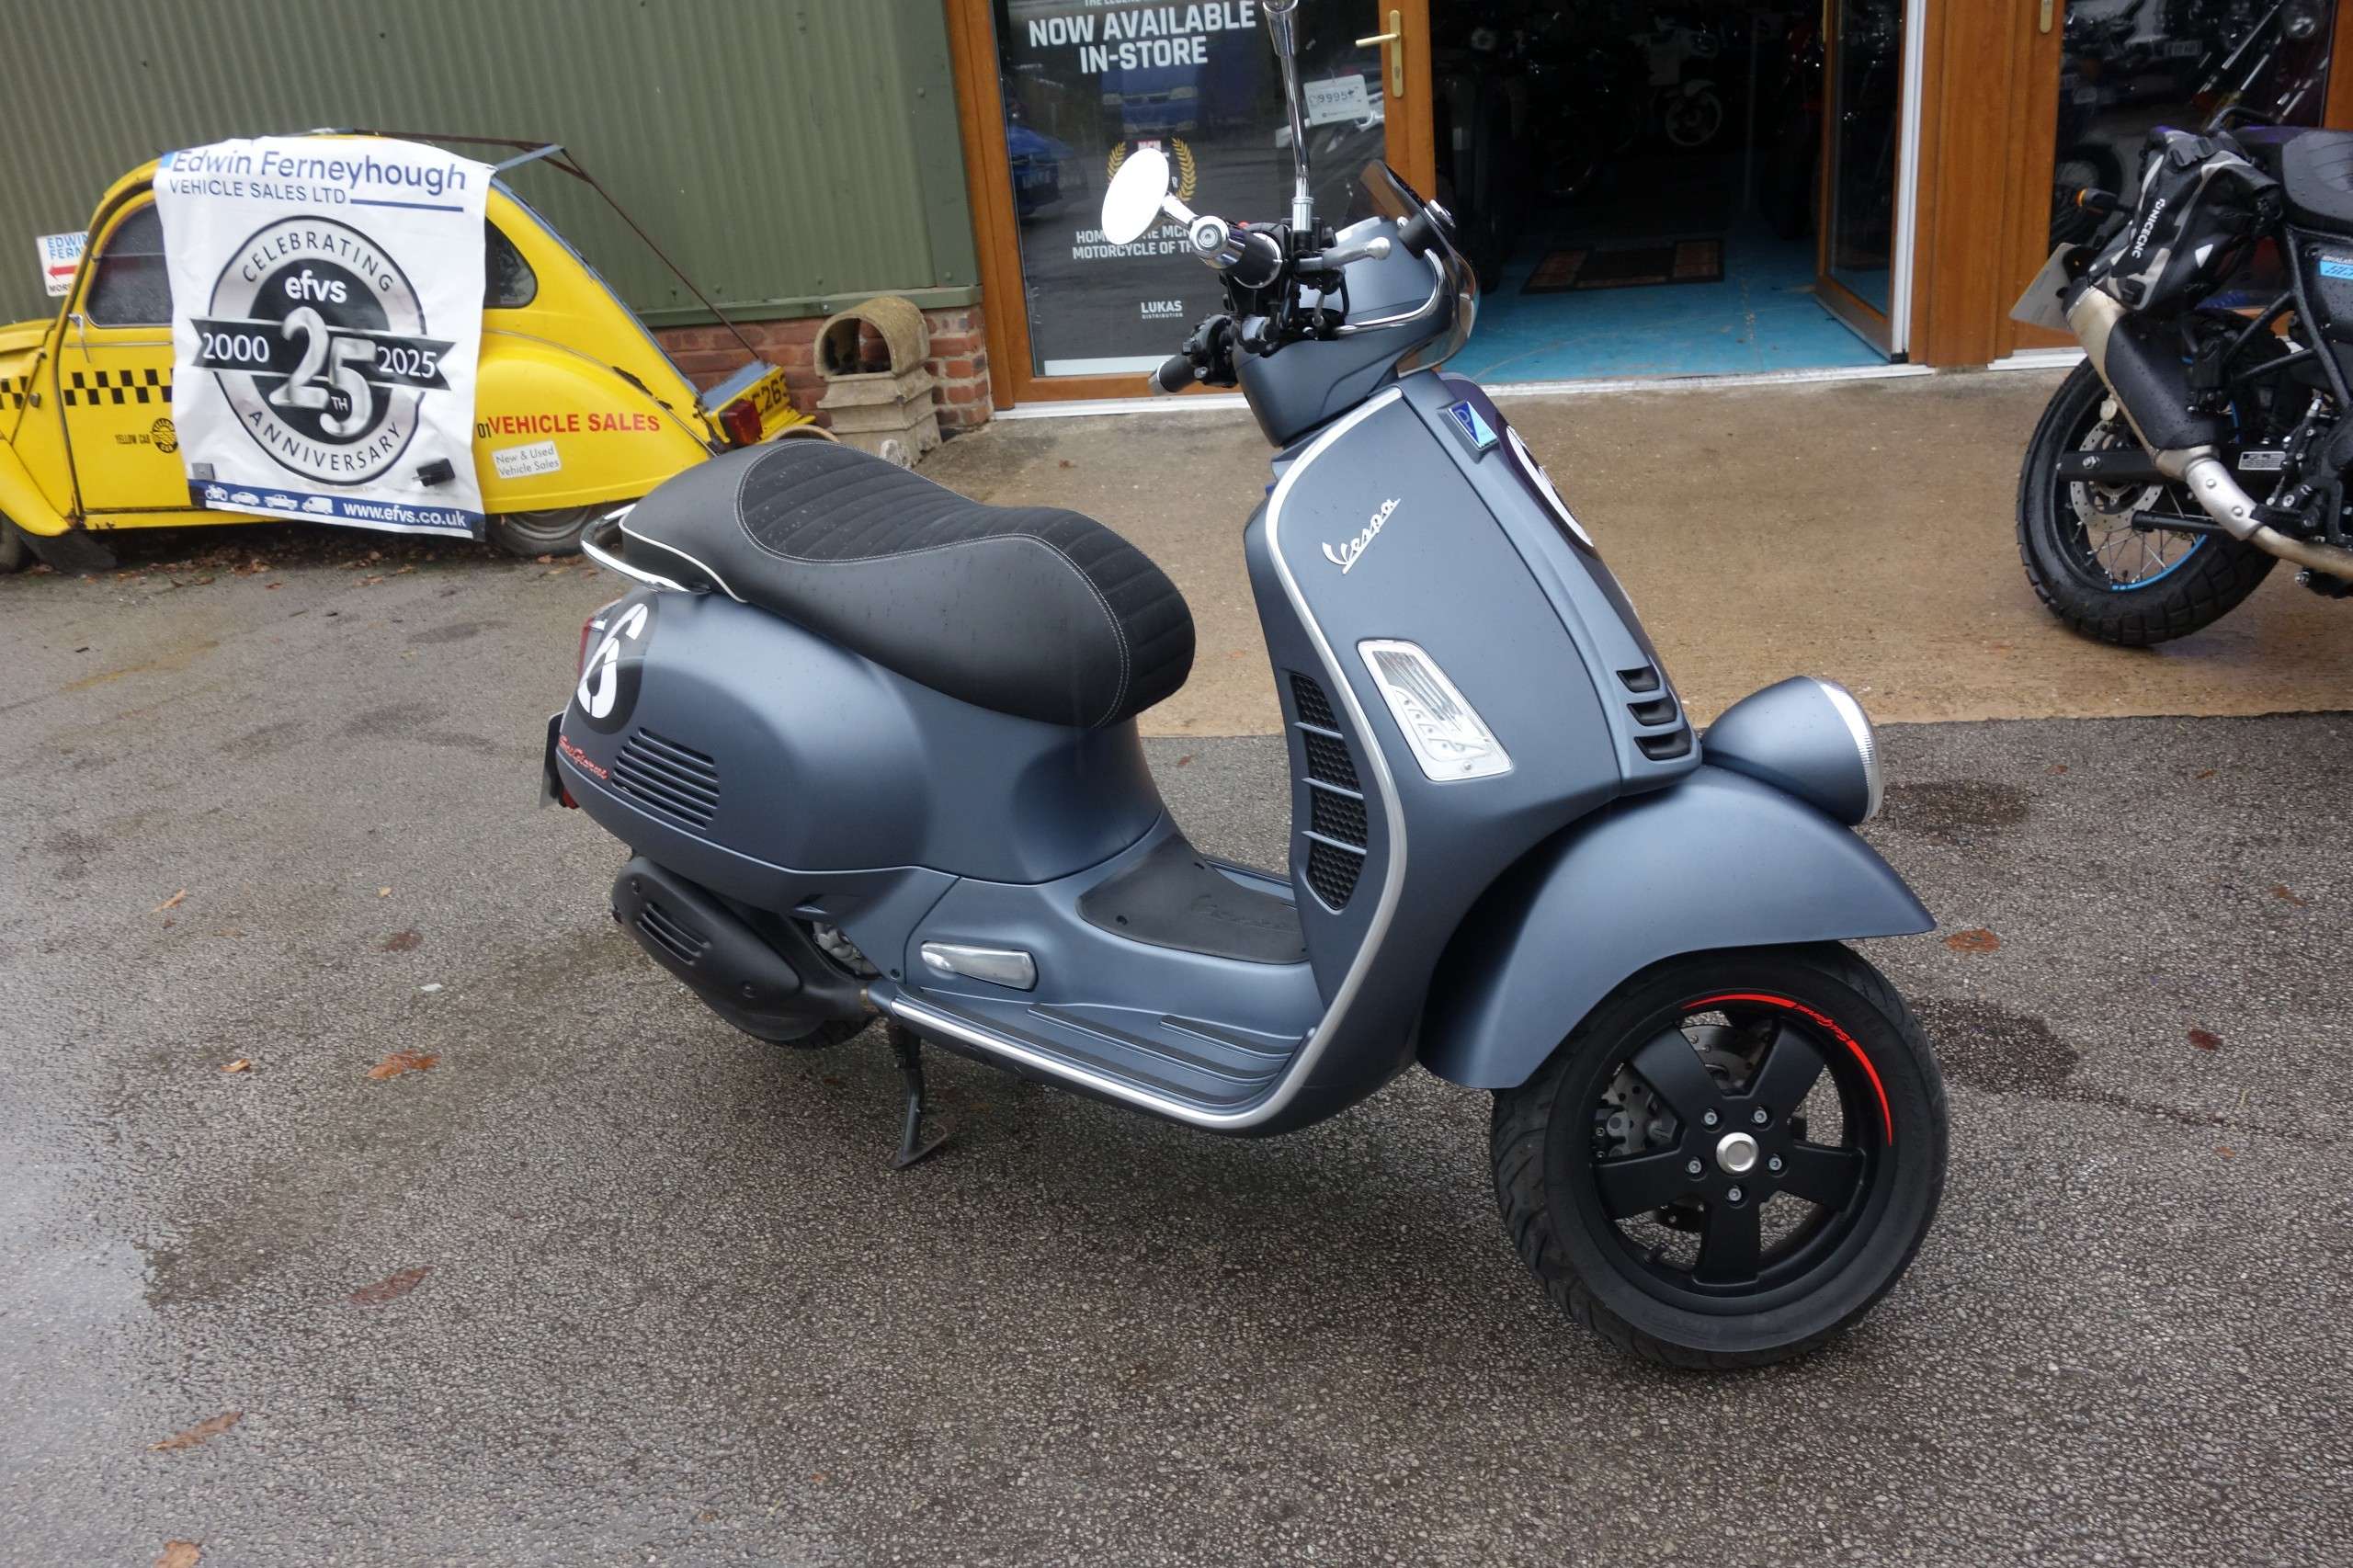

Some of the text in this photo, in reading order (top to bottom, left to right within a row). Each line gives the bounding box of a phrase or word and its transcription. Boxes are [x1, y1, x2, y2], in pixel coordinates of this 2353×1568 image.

[1029, 1, 1256, 47] NOW AVAILABLE
[1079, 36, 1209, 74] IN-STORE
[172, 150, 467, 196] Edwin Ferneyhough
[169, 179, 347, 204] VEHICLE SALES LTD
[1073, 242, 1157, 259] MOTORCYCLE
[1159, 242, 1176, 254] OF
[1075, 230, 1108, 244] HOM
[243, 231, 393, 292] CELEBRATING
[285, 270, 347, 303] efvs
[1141, 300, 1183, 312] LUKAS
[202, 332, 269, 362] 2000
[270, 306, 374, 437] 25
[377, 347, 438, 379] 2025
[332, 396, 347, 411] TH
[487, 413, 661, 435] VEHICLE SALES
[249, 410, 401, 472] ANNIVERSARY
[496, 445, 554, 464] New & Used
[499, 459, 560, 476] Vehicle Sales
[343, 502, 466, 528] www.efvs.co.uk
[1322, 498, 1401, 574] Vespa
